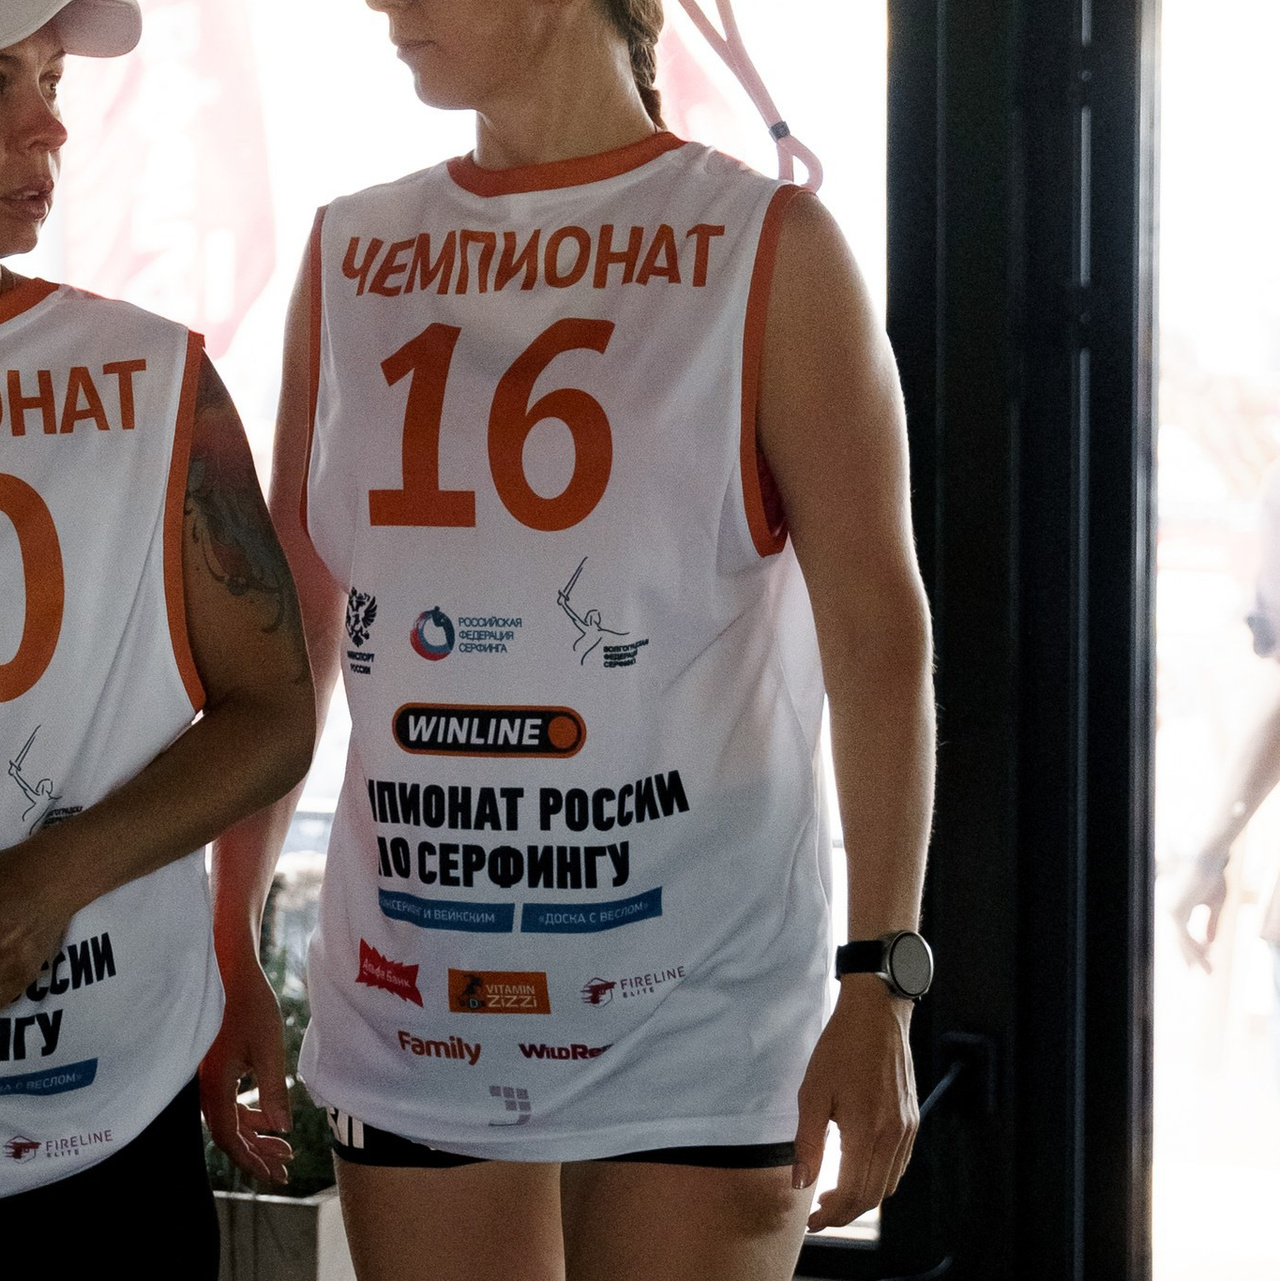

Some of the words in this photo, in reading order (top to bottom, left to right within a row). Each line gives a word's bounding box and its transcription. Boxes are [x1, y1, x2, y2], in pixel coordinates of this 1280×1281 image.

[341, 223, 725, 297] ЧЕМПИОНАТ
[368, 317, 616, 532] 16
[458, 616, 522, 628] РОССИЙСКАЯ
[458, 630, 514, 641] ФЕДЕРАЦИЯ
[458, 642, 508, 653] СЕРФИНГА
[408, 715, 541, 746] WINLINE
[368, 780, 524, 831] ПИОНАТ
[541, 770, 690, 831] РОССИИ
[417, 840, 629, 889] СЕРФИНГУ
[424, 909, 431, 919] И
[434, 909, 495, 923] ВЕЙКСКИМ
[589, 912, 597, 923] С
[620, 966, 687, 990] FIRELINE
[486, 984, 536, 995] VITAMIN
[623, 987, 655, 998] ELITE
[398, 1030, 481, 1066] Family
[46, 1129, 113, 1152] FIRELINE
[46, 1149, 80, 1158] ELITE
